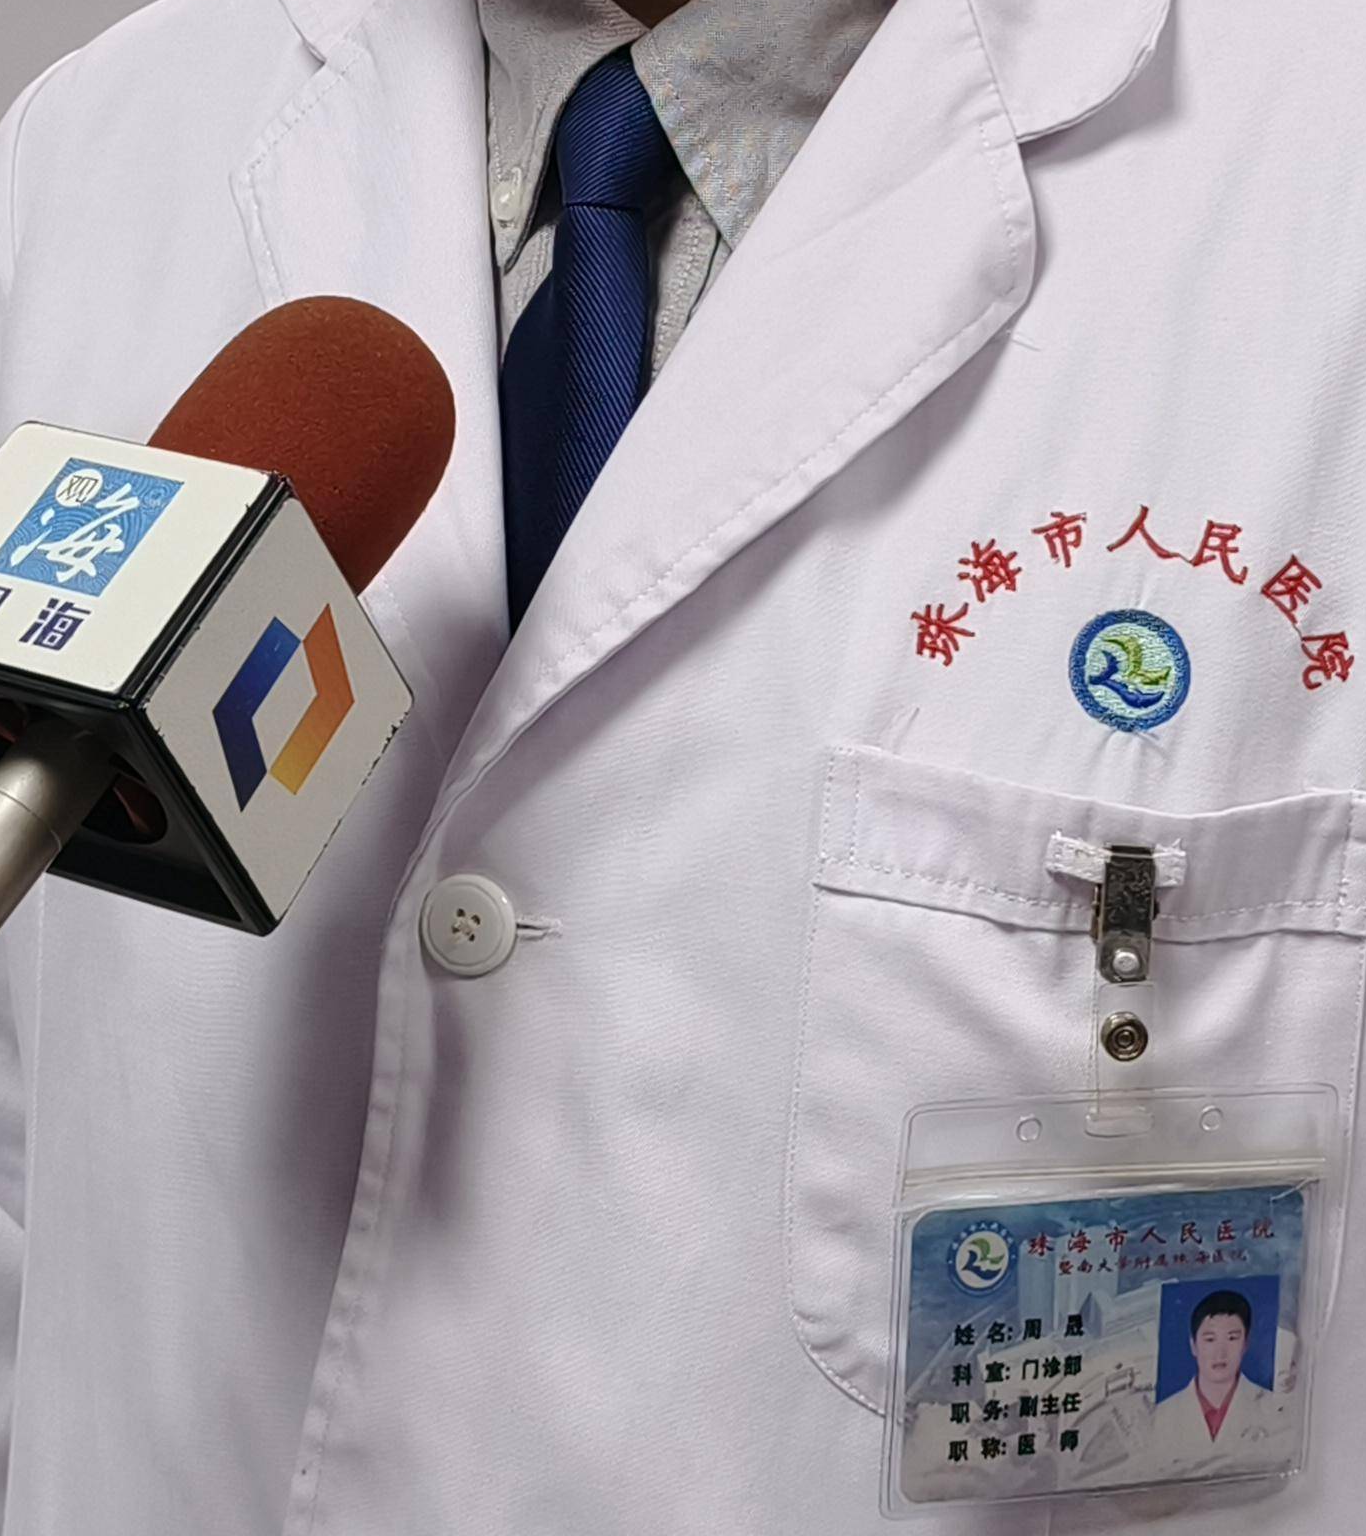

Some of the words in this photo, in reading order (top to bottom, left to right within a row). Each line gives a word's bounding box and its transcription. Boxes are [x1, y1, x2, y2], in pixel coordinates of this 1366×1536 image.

[910, 504, 1355, 691] 珠海市人民医院
[1027, 1218, 1275, 1258] 珠海市人民医院
